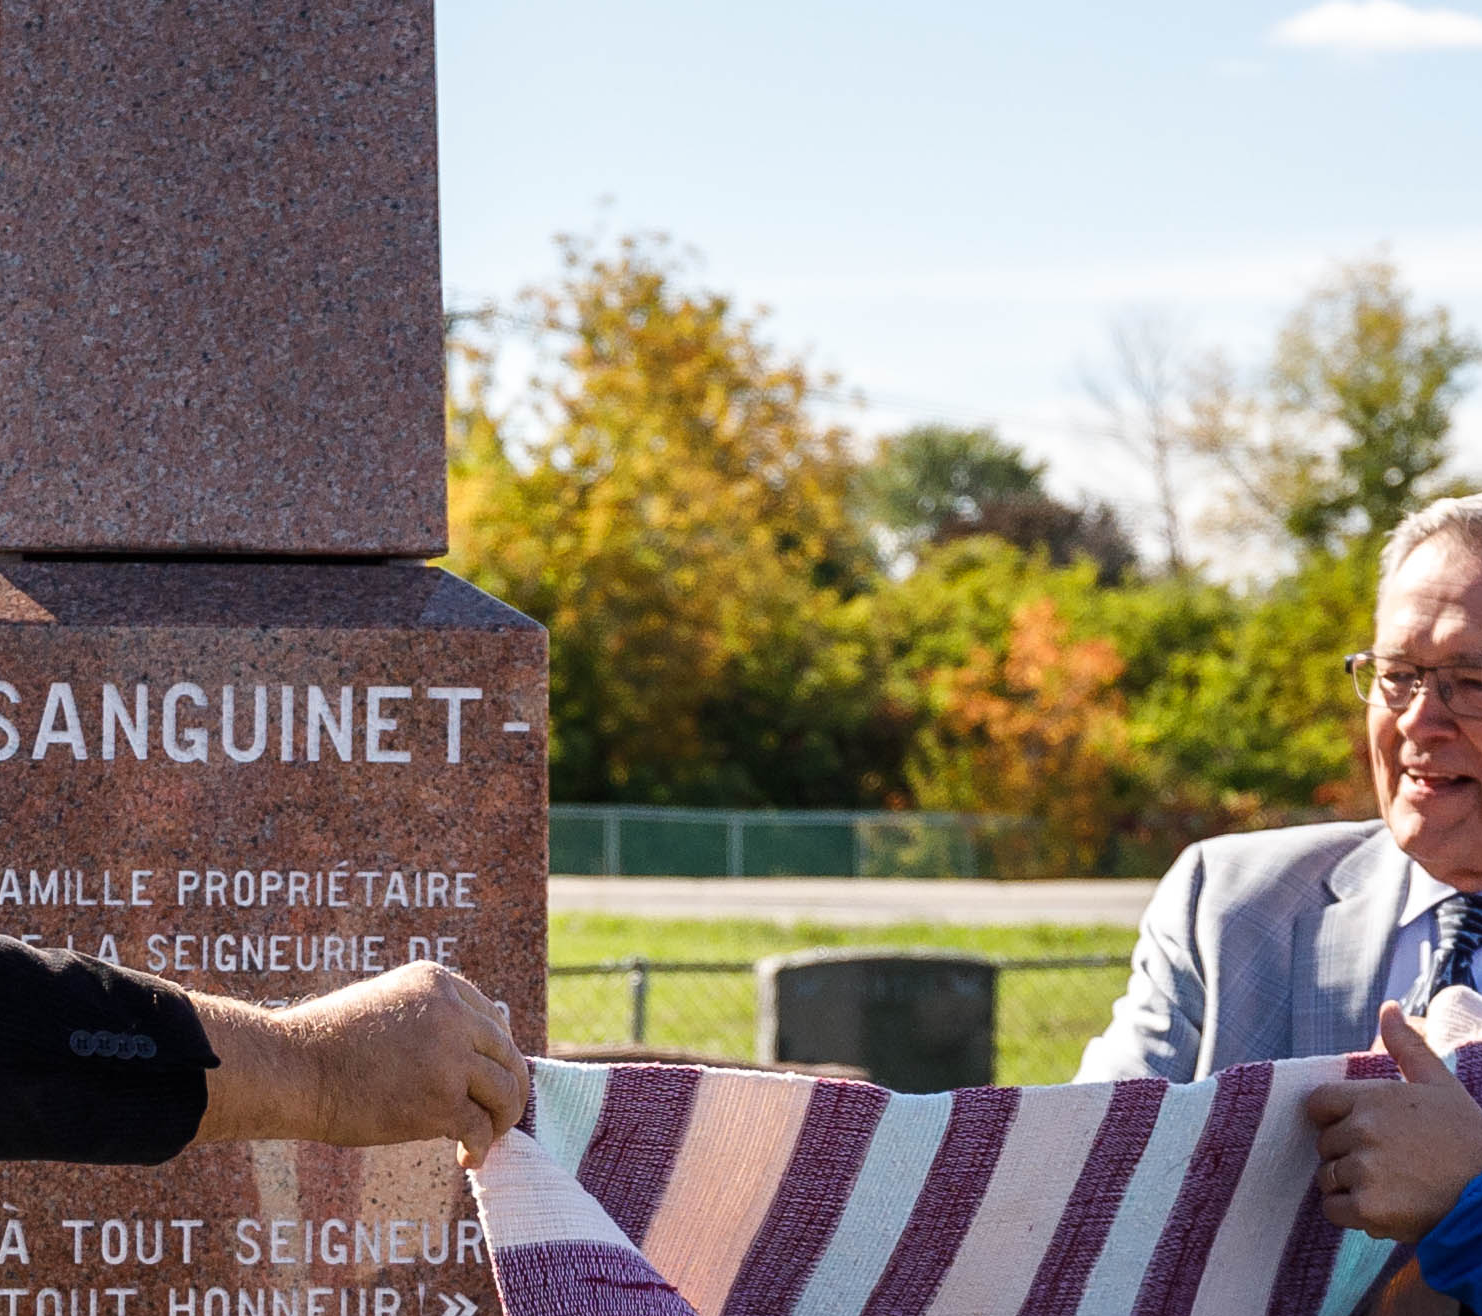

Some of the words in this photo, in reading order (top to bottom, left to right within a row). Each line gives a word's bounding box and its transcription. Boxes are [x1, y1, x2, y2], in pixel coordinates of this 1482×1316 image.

[177, 861, 478, 909] PROPRIÉTAIRE
[146, 933, 386, 974] SEIGNEURIE
[61, 1218, 205, 1267] TOUT
[236, 1217, 486, 1266] SEIGNEUR
